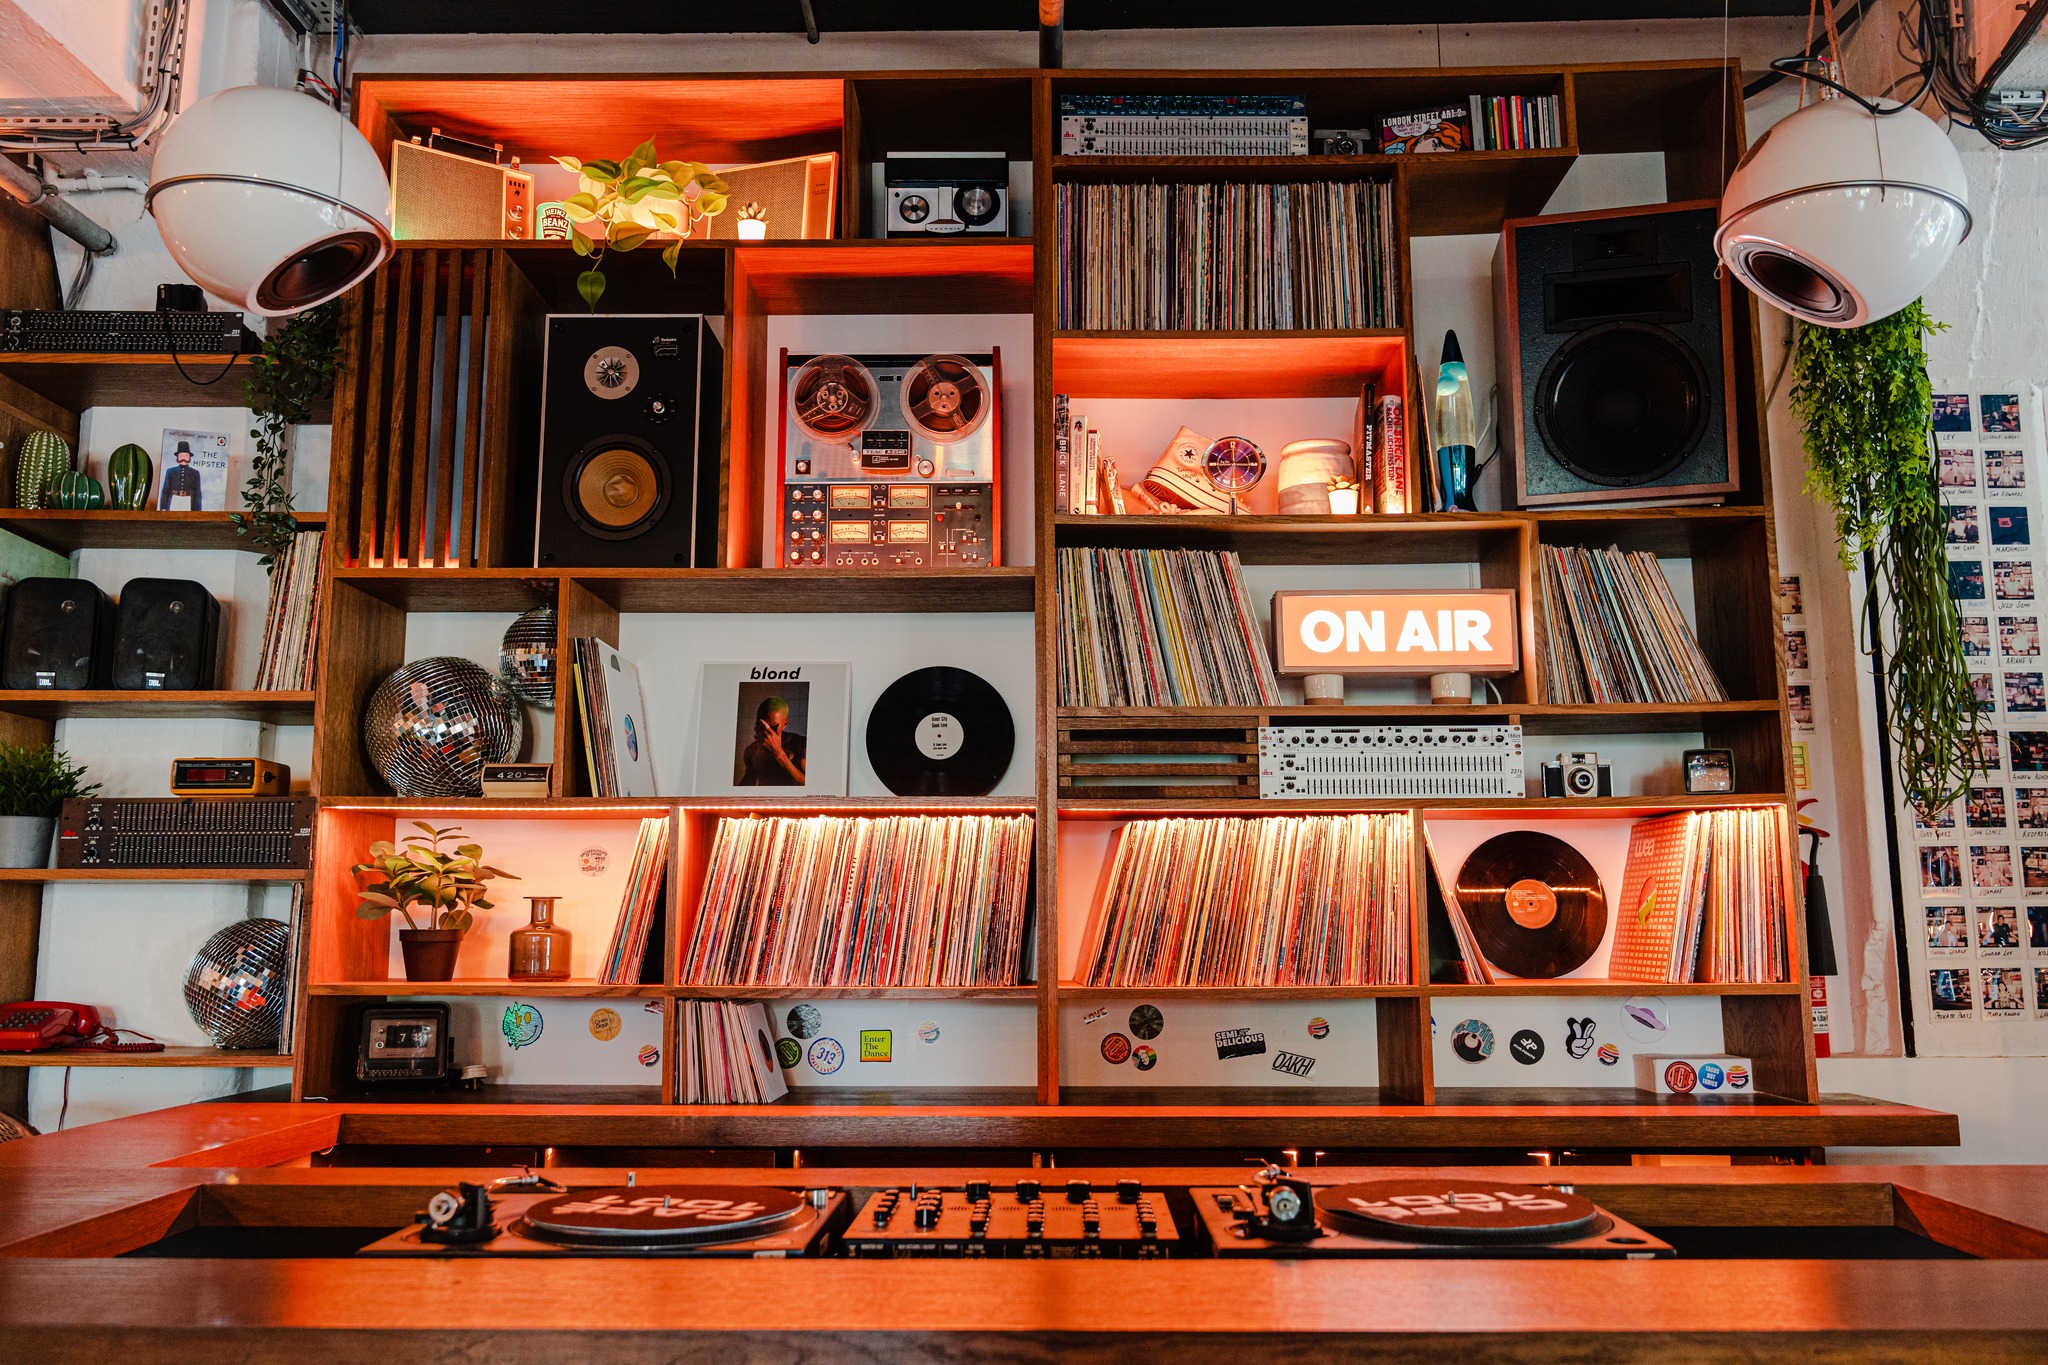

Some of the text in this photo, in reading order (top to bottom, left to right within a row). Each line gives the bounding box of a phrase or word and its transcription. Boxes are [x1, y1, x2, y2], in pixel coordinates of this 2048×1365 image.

[1382, 115, 1411, 127] LONDON
[1414, 112, 1439, 122] STREET
[1442, 110, 1455, 119] ART
[546, 207, 566, 218] HEINZ
[543, 218, 569, 229] BEANZ
[1393, 407, 1403, 496] ON BRICK LANE
[1300, 610, 1494, 653] ON AIR
[750, 667, 801, 680] blond
[1635, 839, 1655, 858] wea
[1216, 1030, 1238, 1041] SEMI
[1217, 1032, 1264, 1048] DELICIOUS
[817, 1047, 836, 1064] 313
[1272, 1053, 1316, 1075] OAKHI
[1705, 1066, 1720, 1074] TACOS
[1702, 1078, 1717, 1088] TORIES
[1347, 1191, 1536, 1206] 1001
[1357, 1198, 1568, 1219] CAFE
